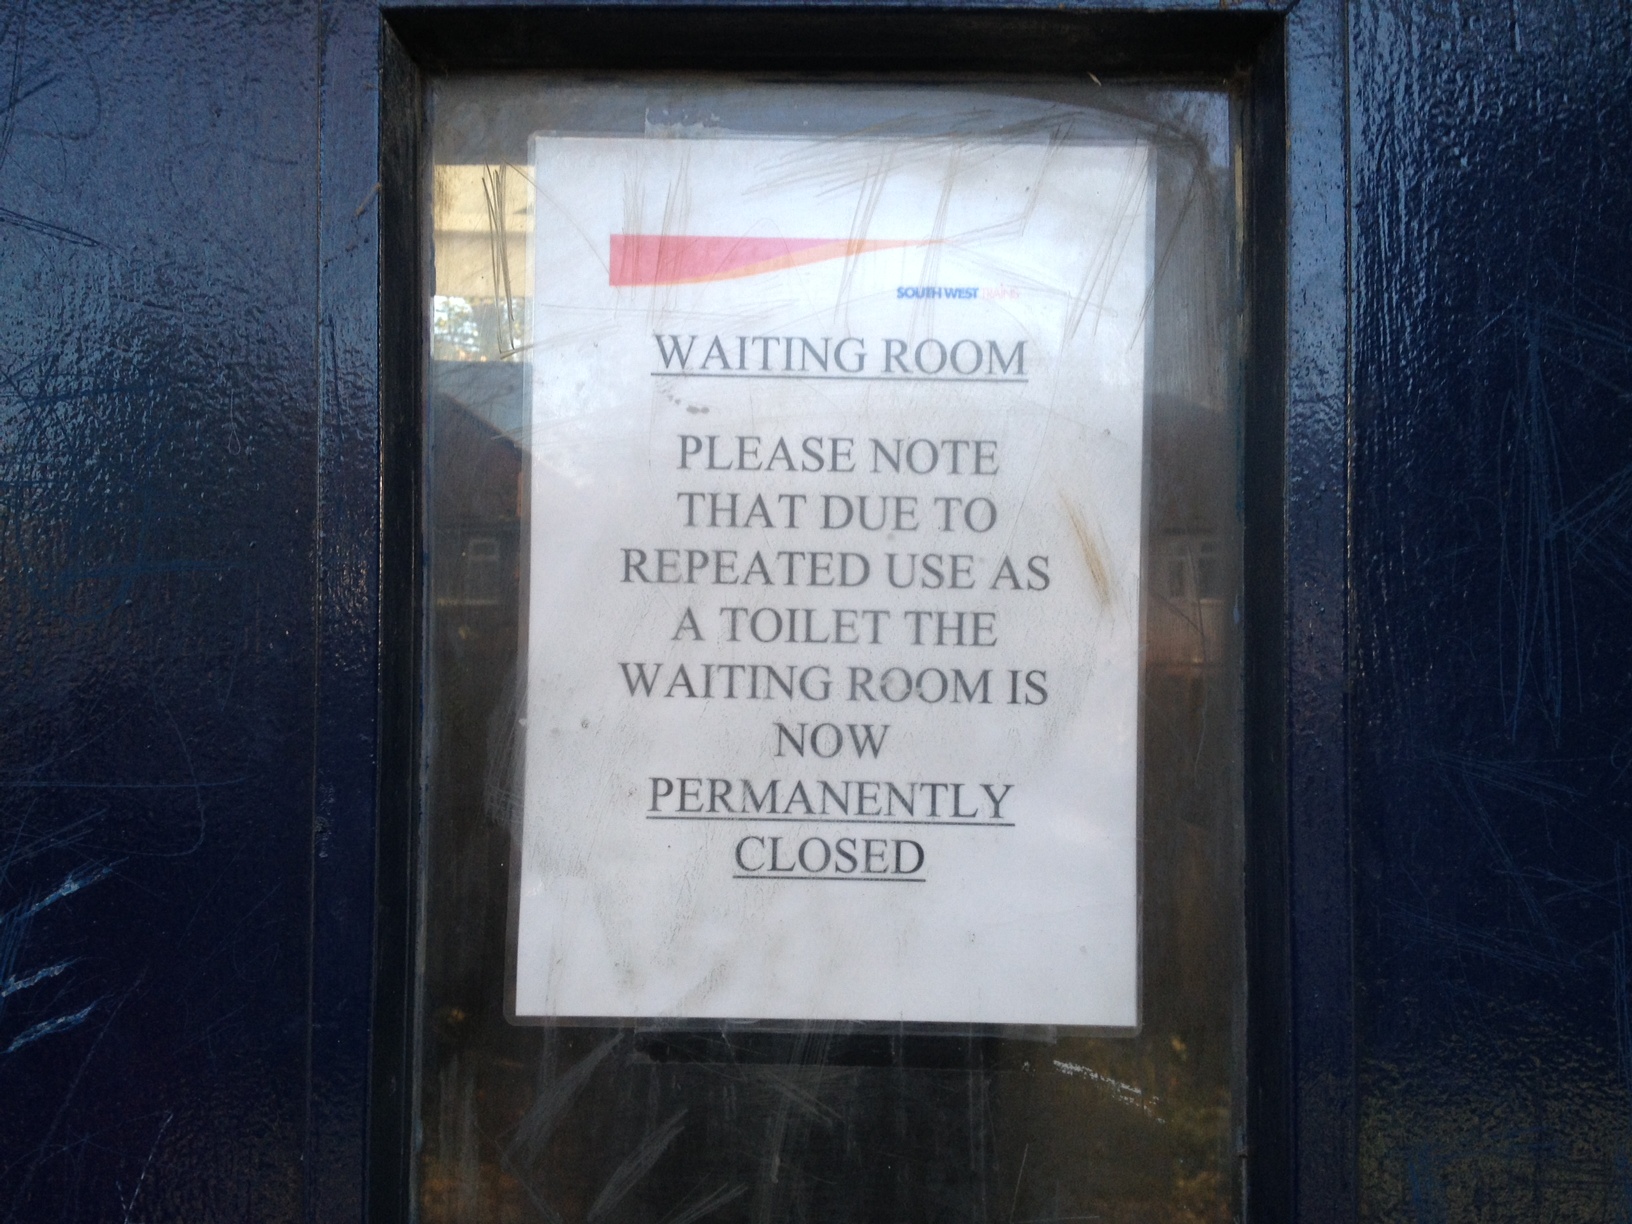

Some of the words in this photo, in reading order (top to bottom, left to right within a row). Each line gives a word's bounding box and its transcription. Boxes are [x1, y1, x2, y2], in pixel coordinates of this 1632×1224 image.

[897, 287, 942, 299] SOUTH
[944, 287, 979, 299] WEST
[654, 334, 867, 373] WAITING
[880, 339, 1029, 376] ROOM
[676, 434, 856, 473] PLEASE
[868, 438, 999, 476] NOTE
[676, 492, 807, 529] THAT
[820, 494, 920, 532] DUE
[933, 497, 998, 533] TO
[620, 548, 871, 588] REPEATED
[885, 553, 975, 590] USE
[989, 555, 1051, 592] AS
[671, 606, 706, 641] A
[719, 607, 890, 645] TOILET
[903, 610, 998, 647] THE
[618, 662, 831, 702] WAITING
[848, 666, 994, 704] ROOM
[1006, 669, 1049, 706] IS
[773, 722, 891, 759] NOW
[647, 777, 1015, 819] PERMANENTLY
[734, 836, 925, 875] CLOSED
